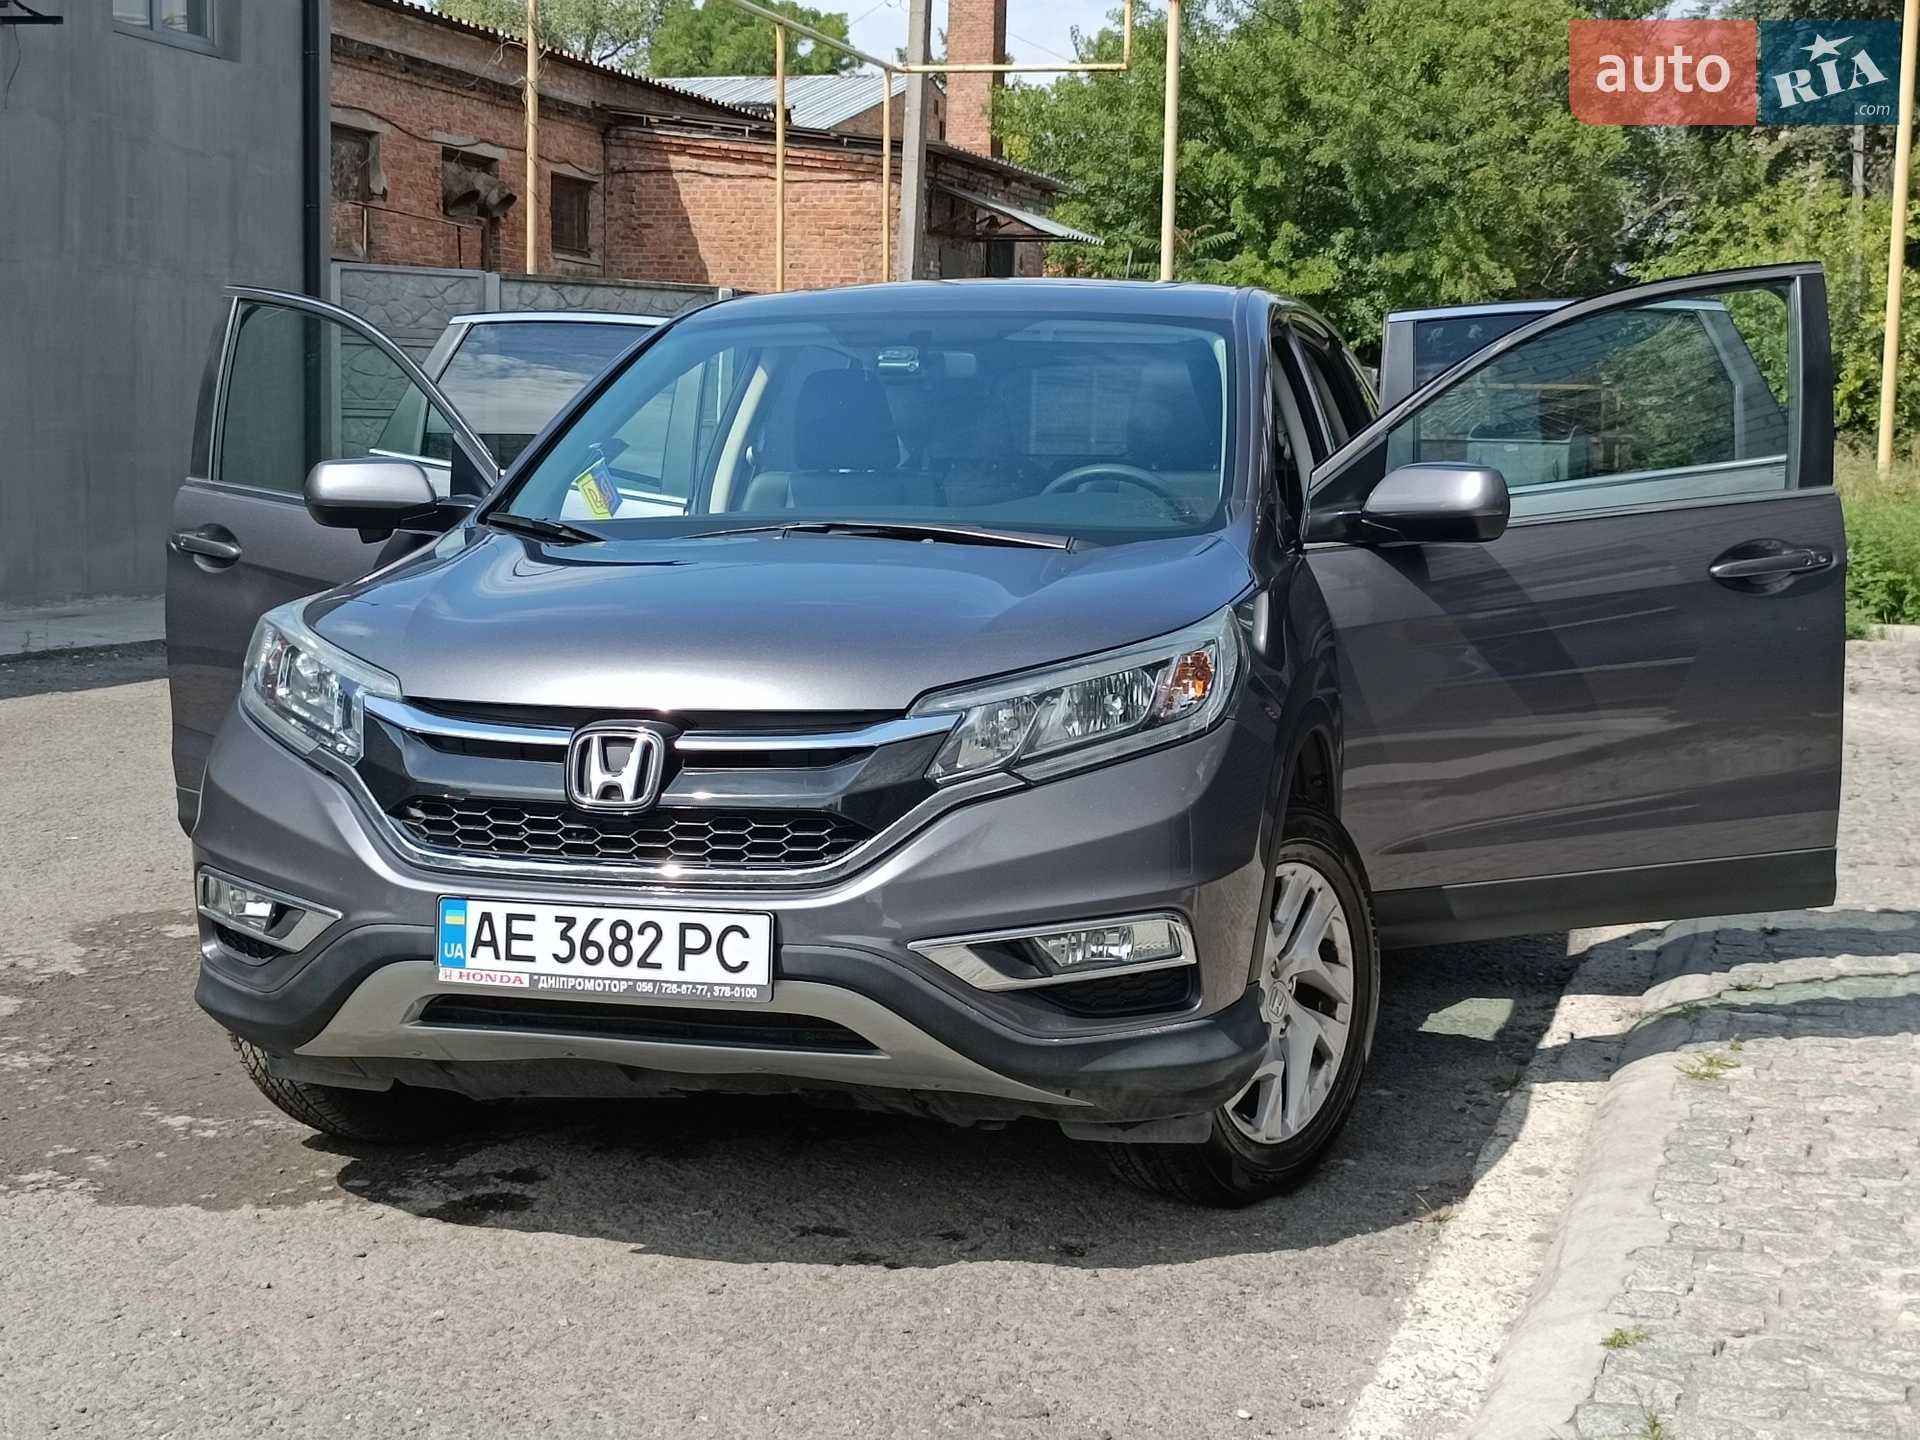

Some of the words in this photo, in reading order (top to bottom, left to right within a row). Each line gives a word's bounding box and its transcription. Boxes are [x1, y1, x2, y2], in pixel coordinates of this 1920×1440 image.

[470, 911, 537, 963] AE
[552, 915, 664, 970] 3682
[678, 922, 751, 974] PC
[444, 943, 465, 959] UA
[458, 971, 525, 985] HONDA
[636, 981, 653, 993] 056
